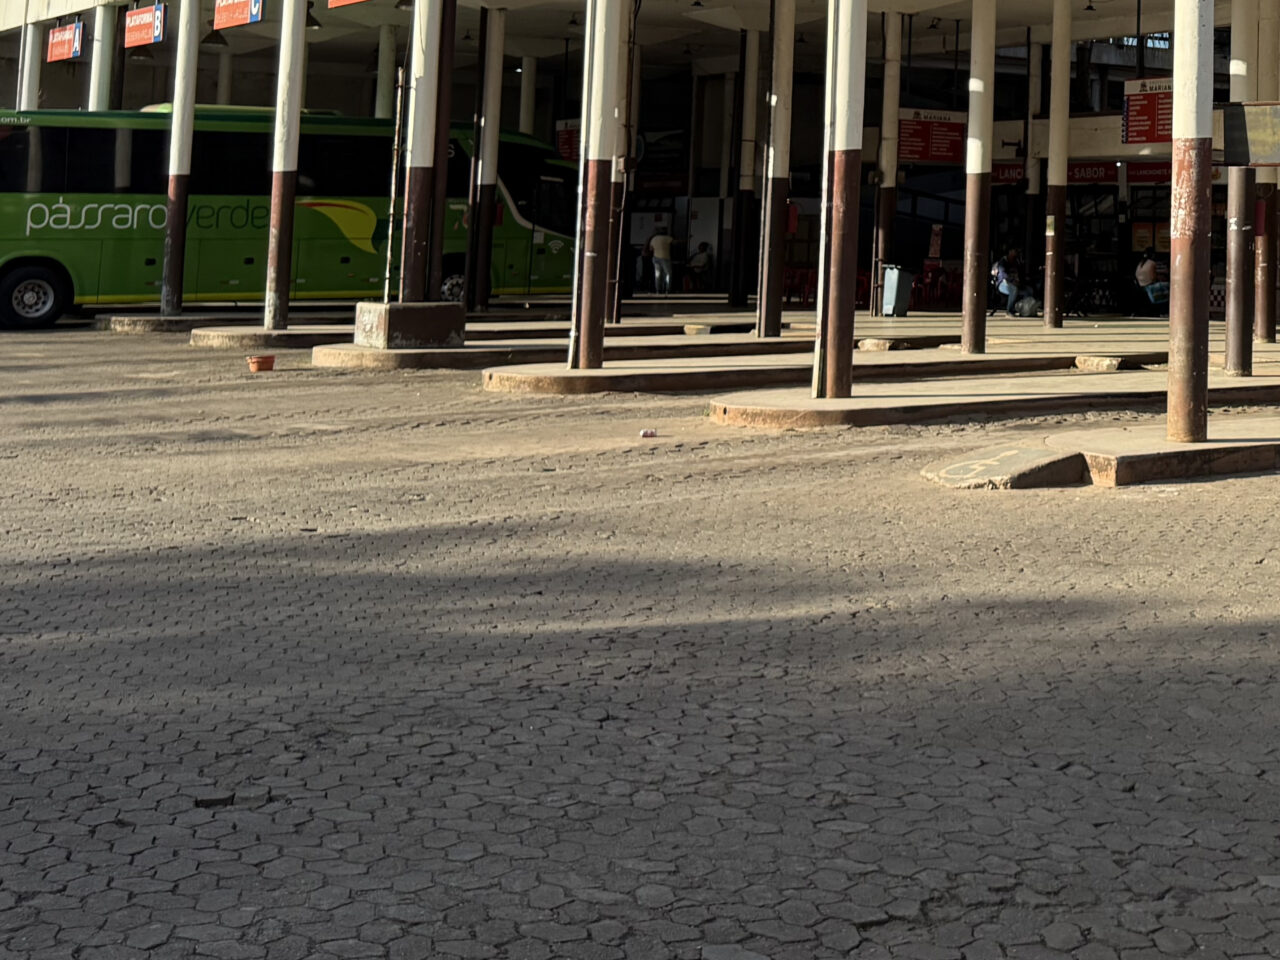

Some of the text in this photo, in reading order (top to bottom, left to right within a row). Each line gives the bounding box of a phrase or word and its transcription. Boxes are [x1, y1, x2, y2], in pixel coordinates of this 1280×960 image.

[154, 10, 161, 37] B
[73, 28, 80, 52] A
[1074, 167, 1105, 179] SABOR
[26, 195, 168, 236] pássaro
